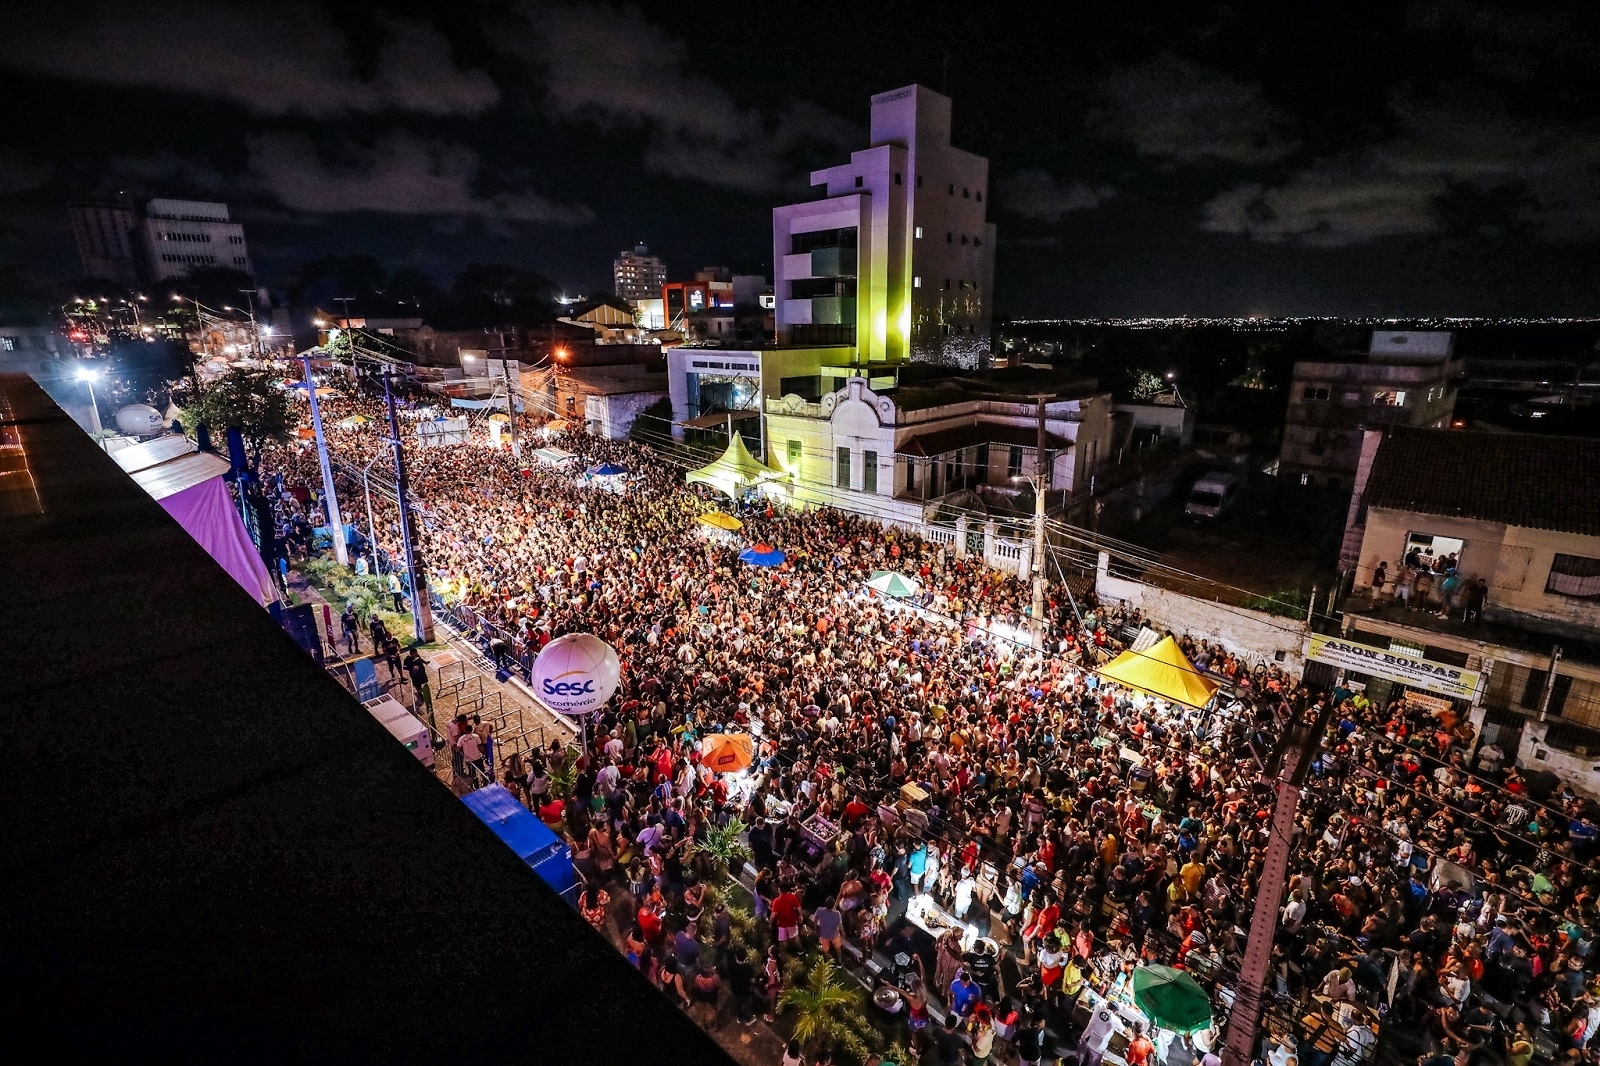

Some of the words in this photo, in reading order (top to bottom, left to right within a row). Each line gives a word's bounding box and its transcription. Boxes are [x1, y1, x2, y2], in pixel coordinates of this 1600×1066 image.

[1325, 641, 1379, 660] ARON
[1383, 654, 1461, 680] BOLSAS
[543, 678, 595, 696] Sesc
